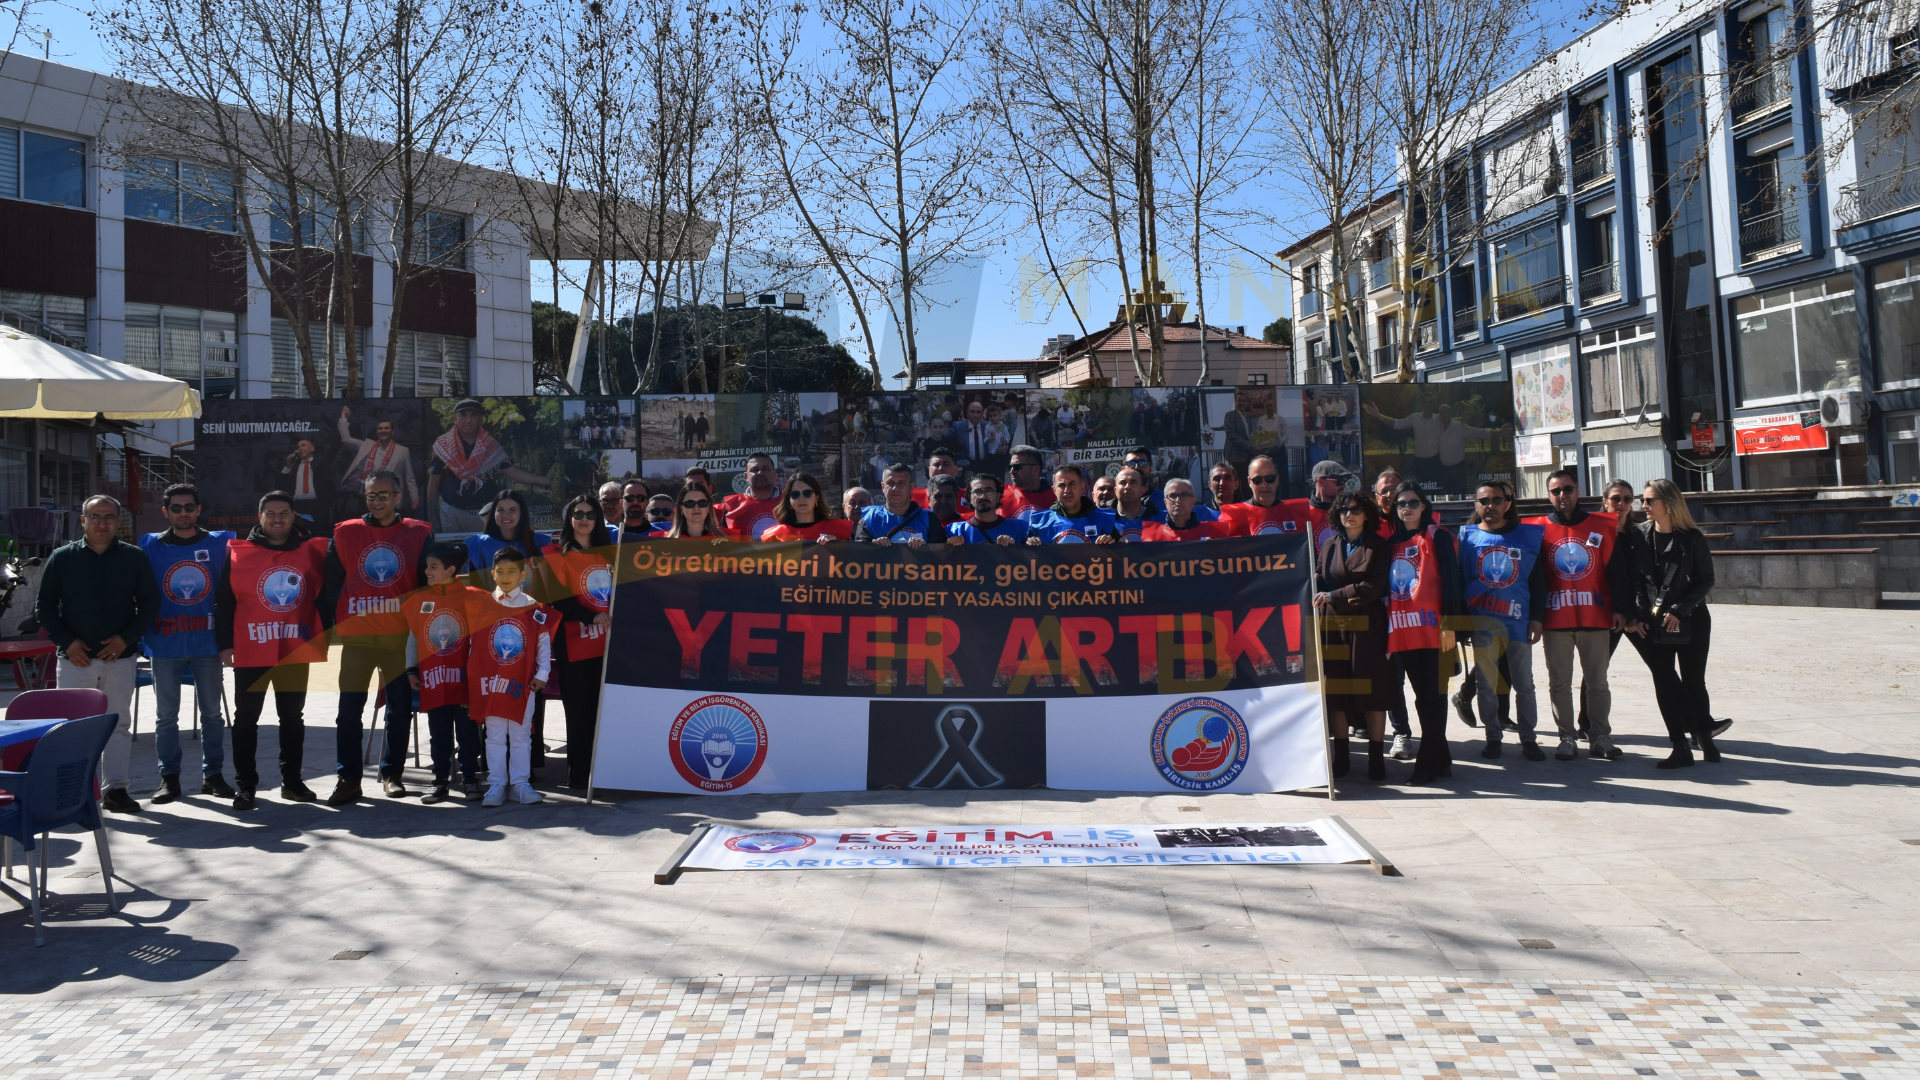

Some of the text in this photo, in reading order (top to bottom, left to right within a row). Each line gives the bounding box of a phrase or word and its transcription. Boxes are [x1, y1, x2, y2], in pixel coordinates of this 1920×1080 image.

[202, 419, 320, 434] SENİ UNUTMAYACAĞIZ...
[1768, 416, 1787, 424] BABAM
[1087, 437, 1137, 448] HALKLA İÇ İÇE
[700, 446, 783, 458] HEP BİRLİKTE DURMADAN
[1073, 449, 1092, 460] BİR
[633, 545, 1296, 587] Öğretmenleri korursanız, geleceği korursunuz.
[781, 585, 1144, 609] EĞİTİMDE ŞİDDET YASASINI ÇIKARTIN!
[663, 603, 1304, 687] YETER ARTIK!
[671, 696, 766, 746] EĞİTİM VE BİLİM İŞGÖRENLERİ SENDİKASI
[1163, 763, 1241, 789] BİRLEŞİK KAMU-İŞ
[700, 780, 733, 790] EĞİTİM-İŞ
[838, 827, 1135, 843] EĞİTİM-İŞ
[1023, 841, 1139, 849] GÖRENLERİ
[743, 851, 1303, 868] SARIGÖL İLÇE TEMSİLCİLİĞİ
